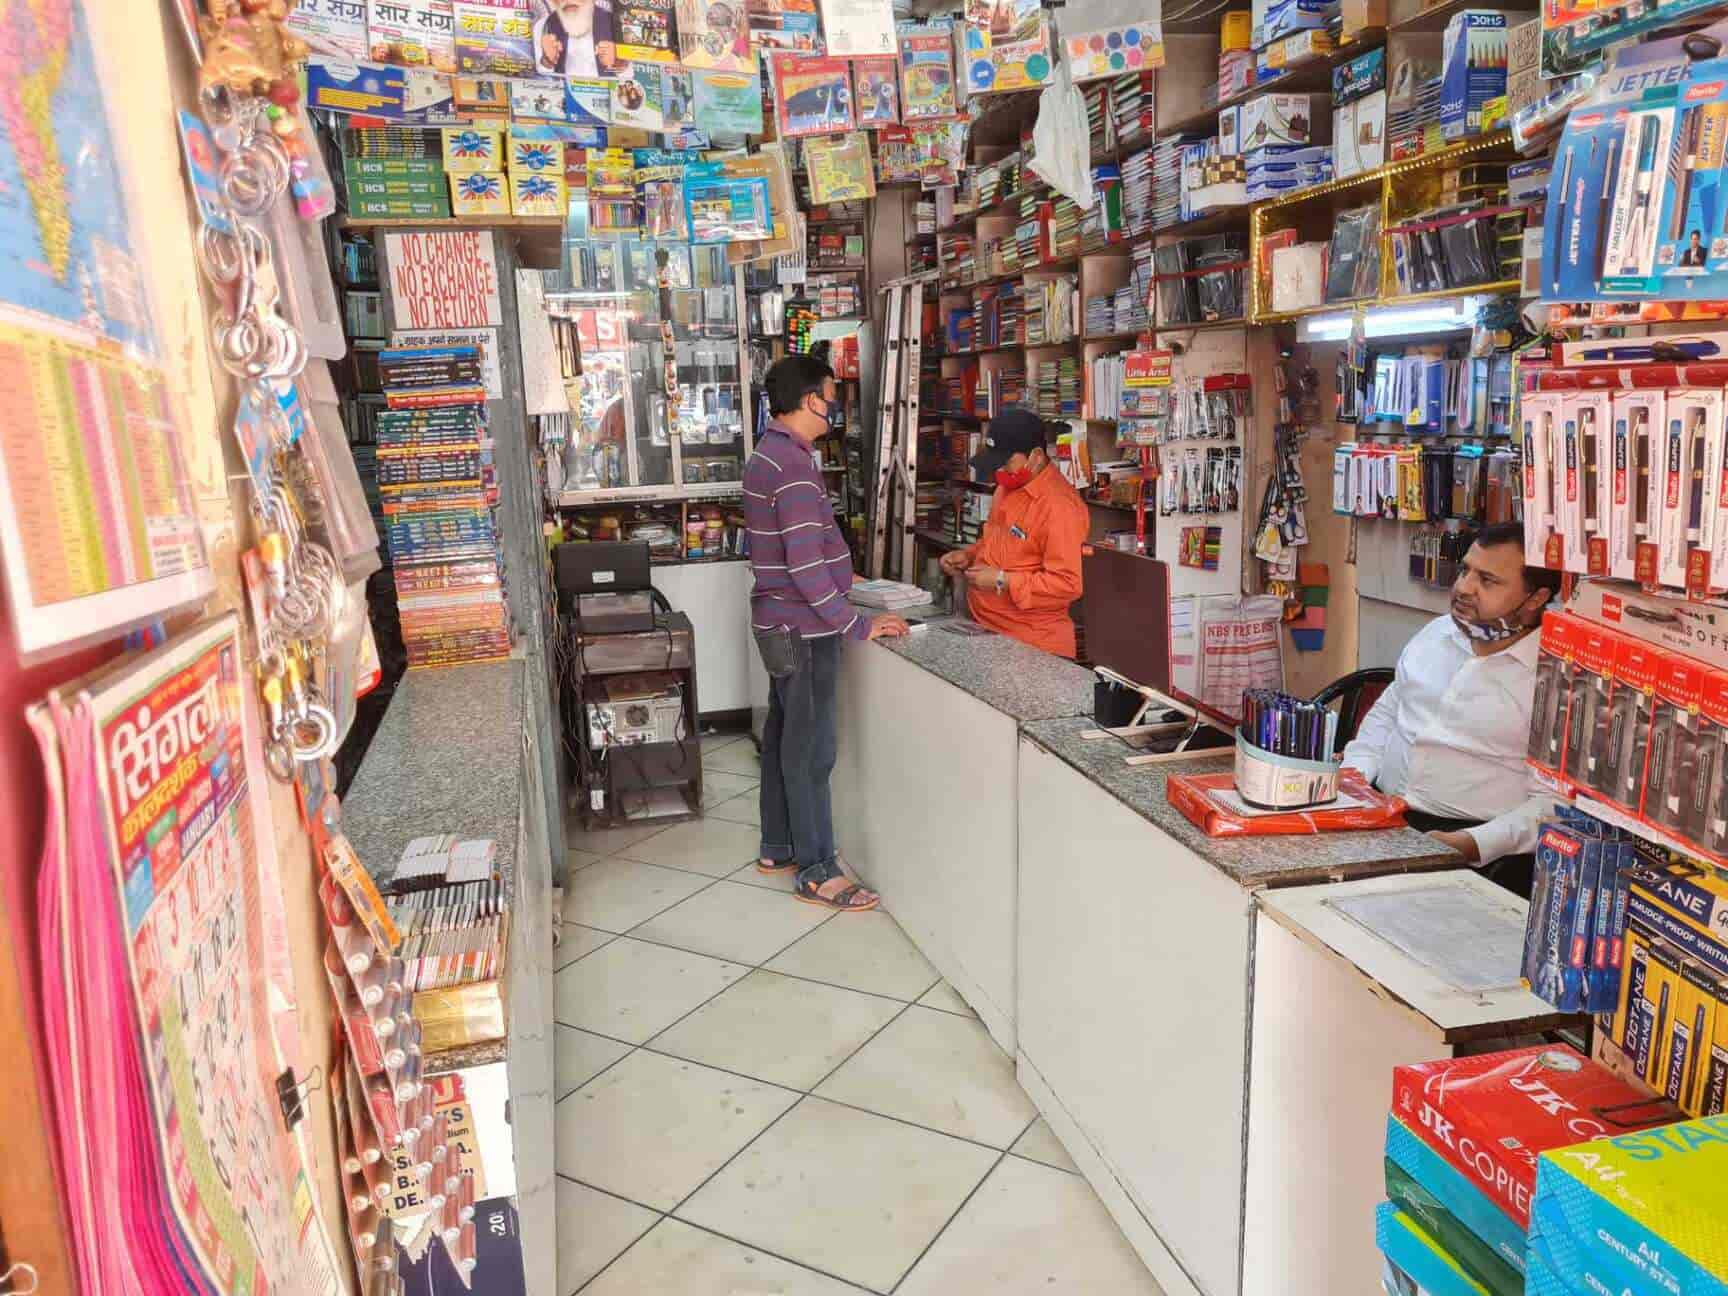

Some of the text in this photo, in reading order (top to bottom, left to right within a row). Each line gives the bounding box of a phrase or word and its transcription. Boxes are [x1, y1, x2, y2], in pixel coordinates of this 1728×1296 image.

[401, 231, 482, 266] NO CHANGE
[396, 262, 495, 301] NO EXCHANGE
[408, 295, 489, 329] NO RETURN
[1627, 966, 1646, 1051] OCTANE
[1636, 1017, 1653, 1076] OCTANE
[1668, 1036, 1686, 1101] OCTANE
[1418, 1101, 1458, 1150] JK
[1596, 1227, 1649, 1271] CENTURY
